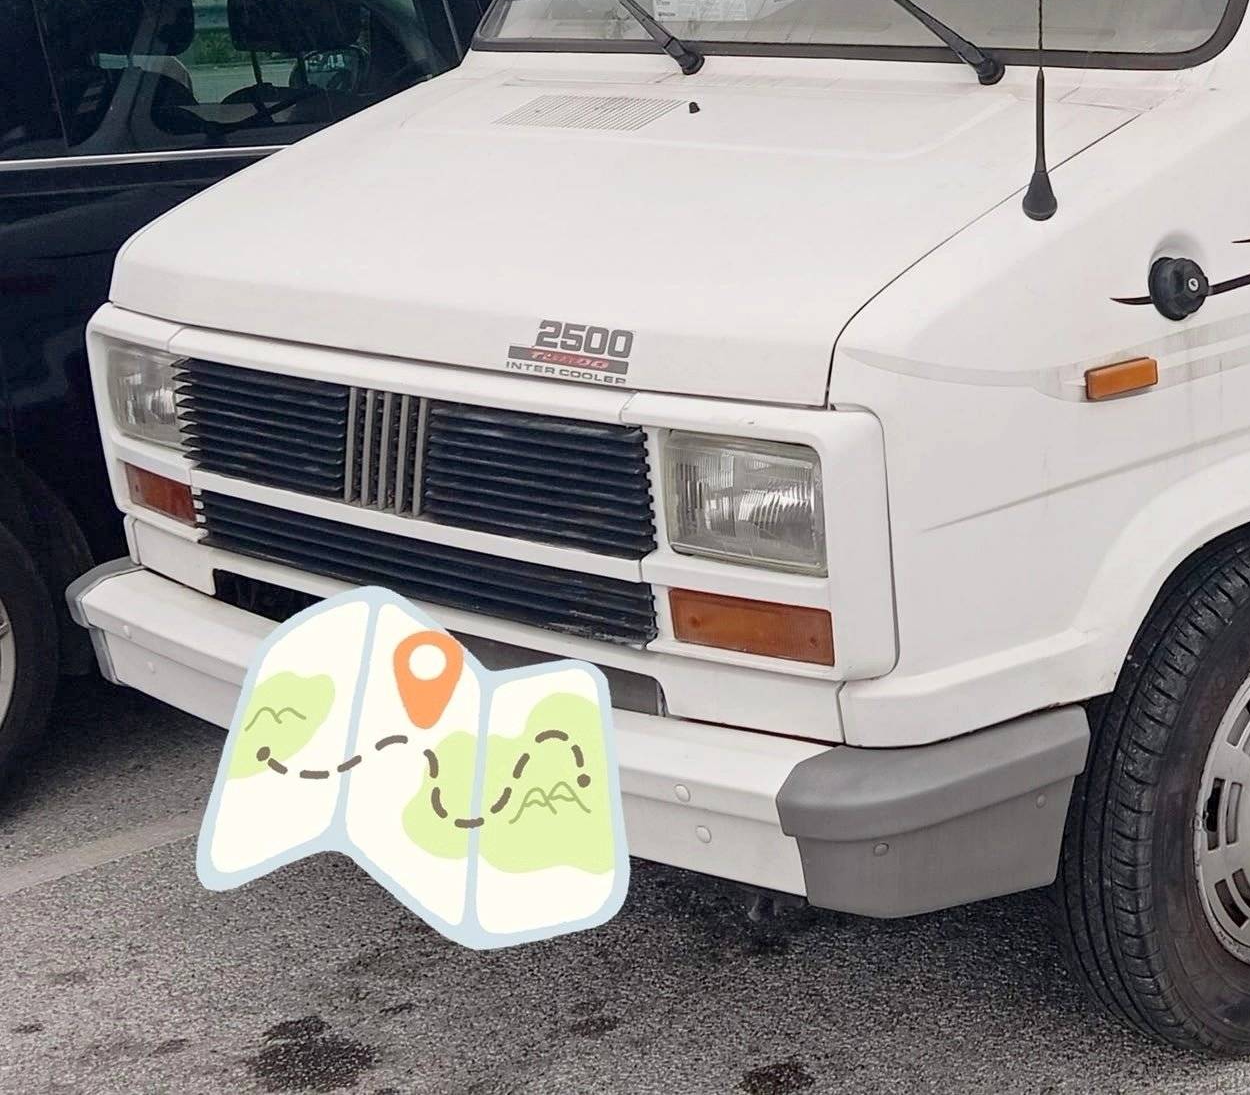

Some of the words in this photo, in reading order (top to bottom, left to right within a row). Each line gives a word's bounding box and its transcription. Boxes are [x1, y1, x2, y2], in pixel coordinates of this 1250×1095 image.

[535, 319, 633, 358] 2500
[506, 361, 555, 374] INTER
[559, 369, 626, 384] COOLER
